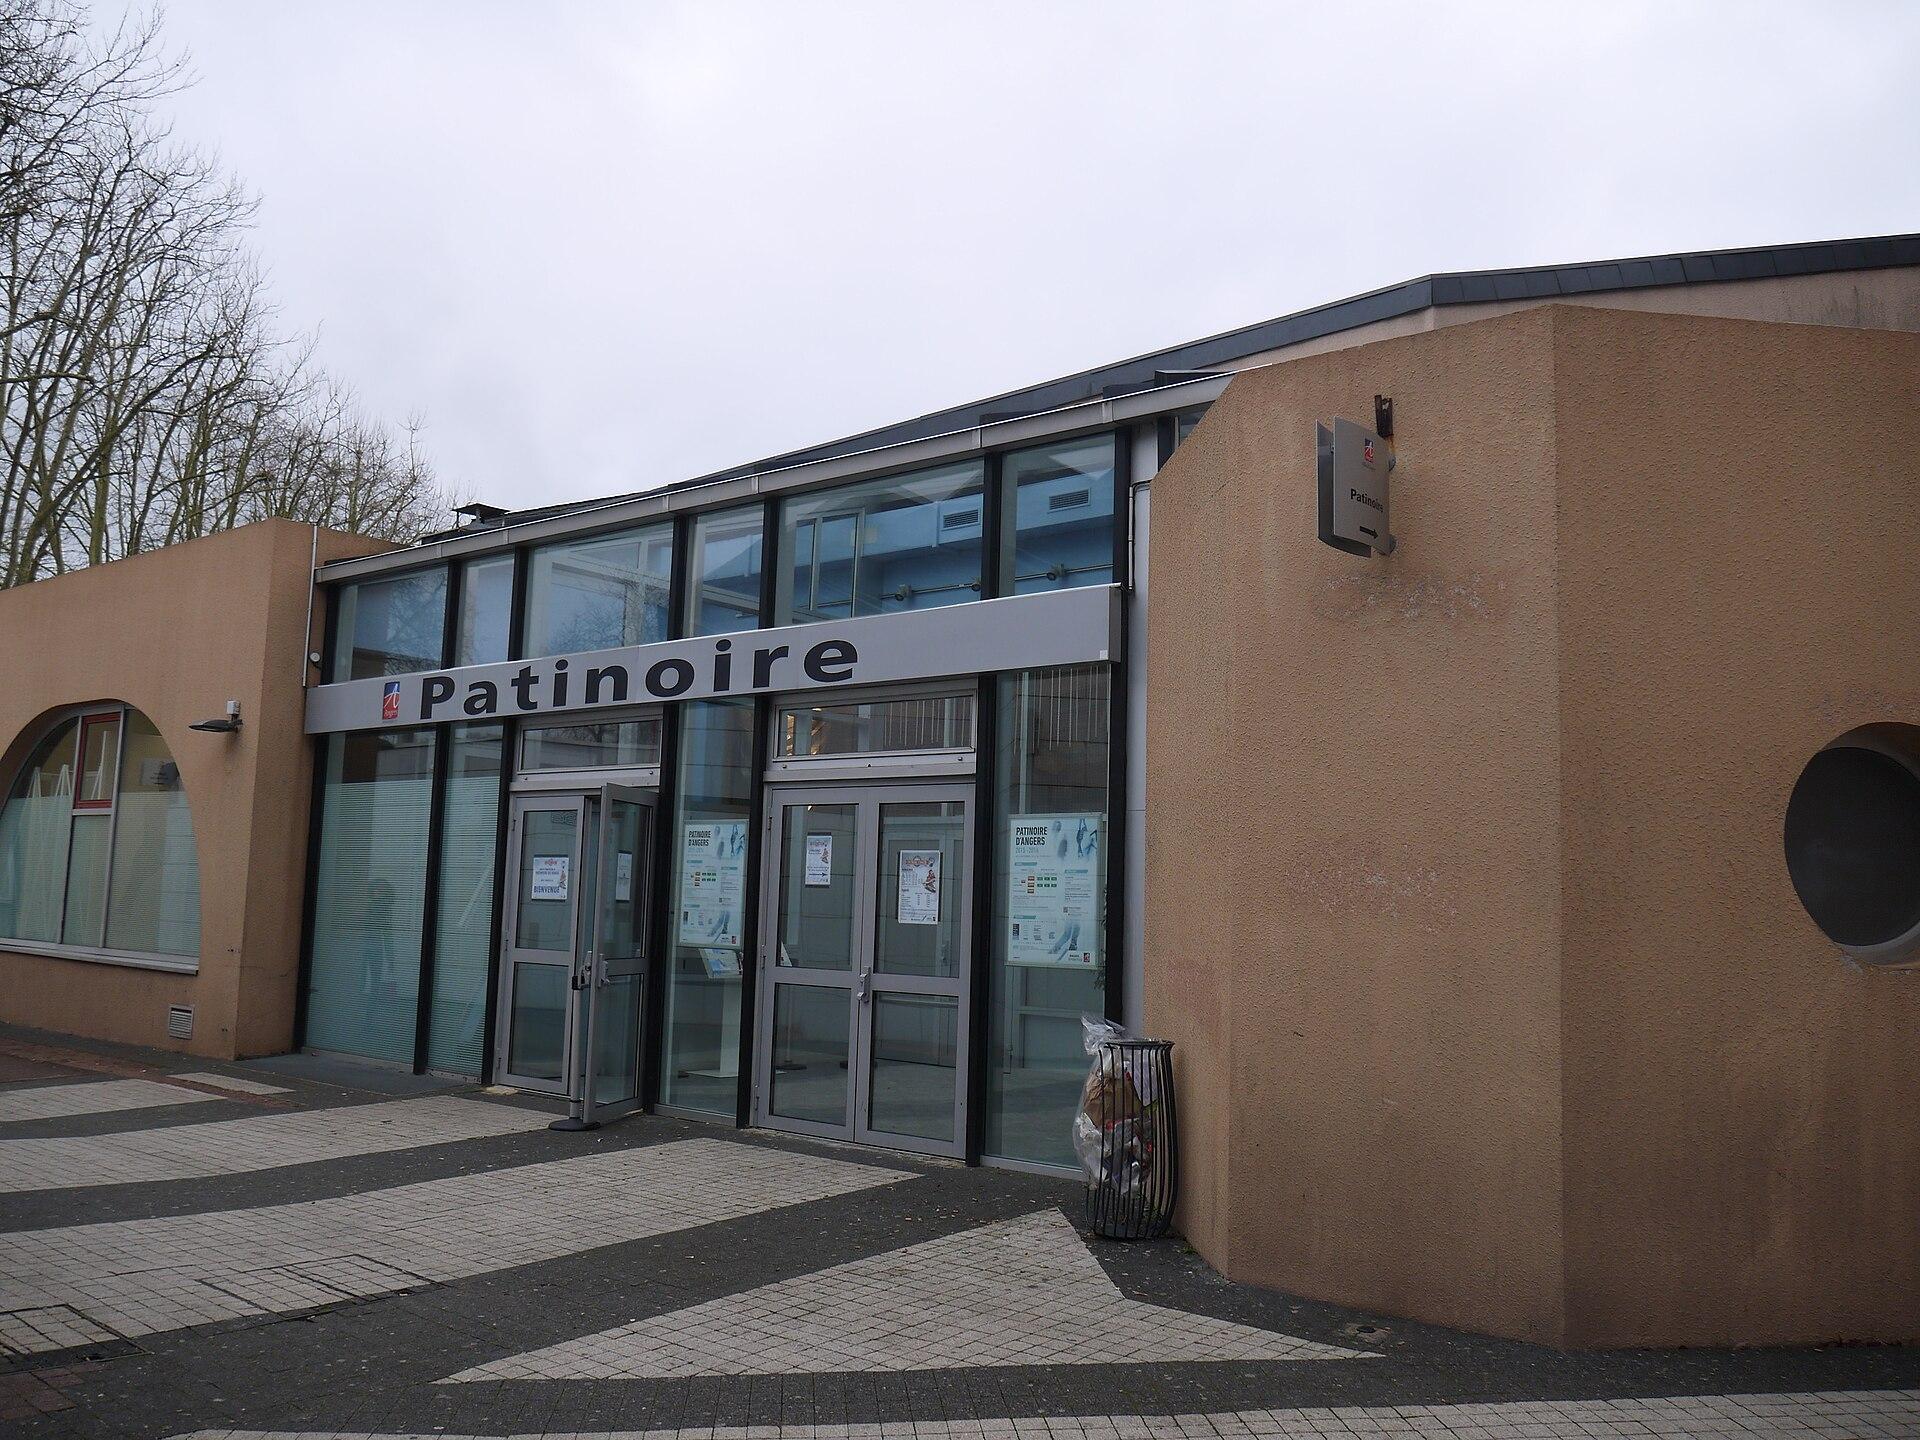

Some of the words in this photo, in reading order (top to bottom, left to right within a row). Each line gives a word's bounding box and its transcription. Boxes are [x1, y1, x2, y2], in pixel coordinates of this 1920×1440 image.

[420, 638, 858, 719] Patinoire
[1015, 826, 1048, 836] PATINOIRE
[1015, 836, 1046, 846] D'ANGERS
